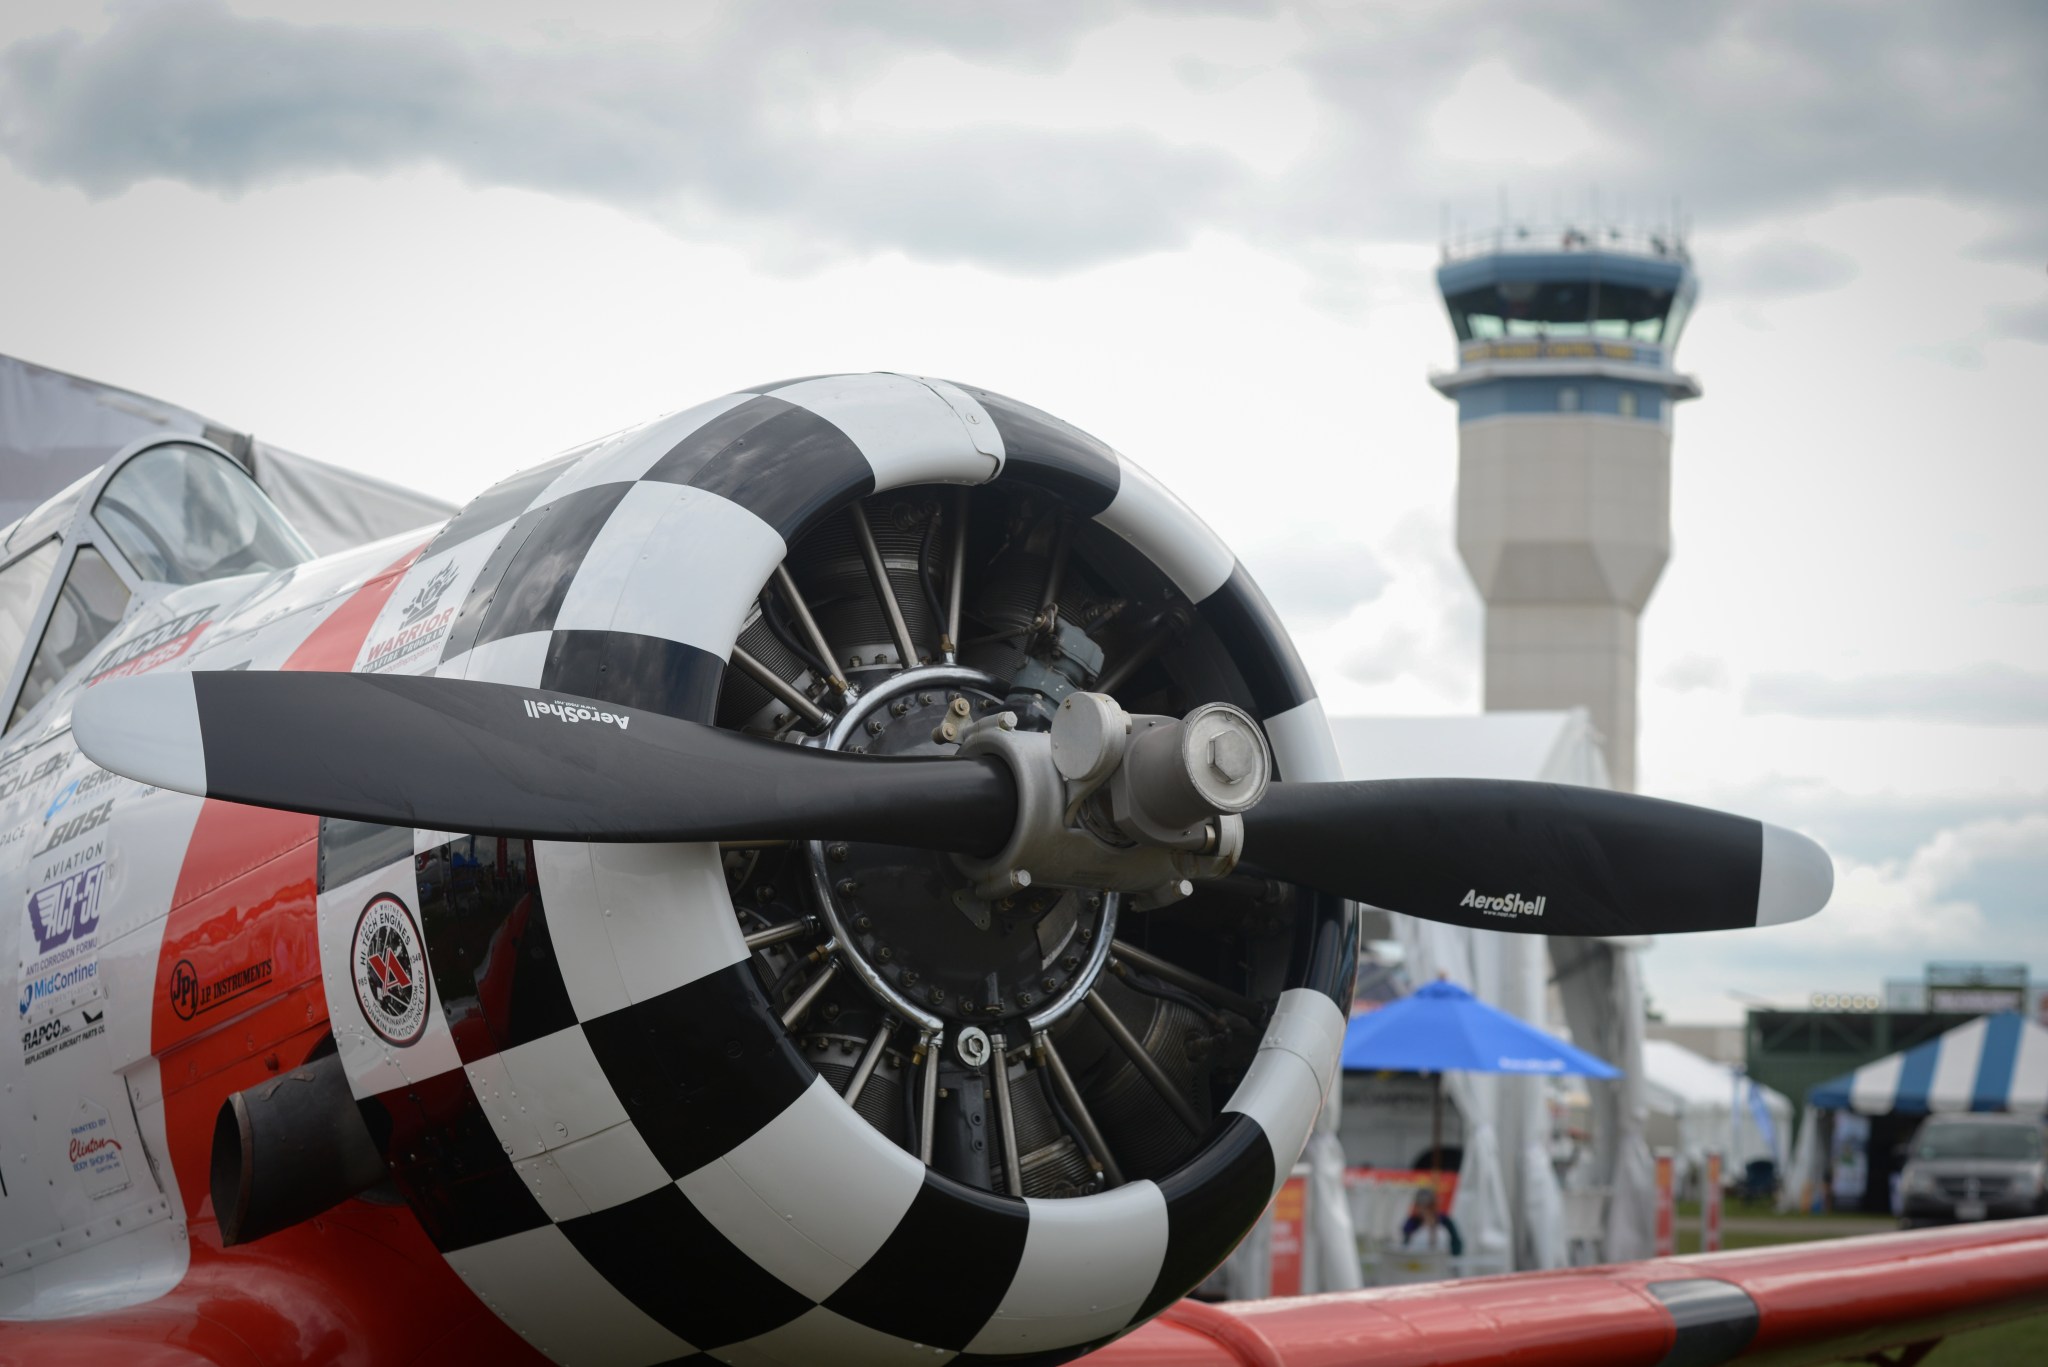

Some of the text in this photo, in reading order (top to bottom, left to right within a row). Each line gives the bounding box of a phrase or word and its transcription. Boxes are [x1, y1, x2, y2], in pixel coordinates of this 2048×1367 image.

[367, 607, 455, 663] WARRIOR
[524, 700, 629, 729] AeroShell
[41, 798, 115, 855] BOSE
[44, 840, 103, 882] AVIATION
[1460, 889, 1546, 916] AeroShell
[380, 913, 411, 947] ENGINES
[26, 961, 39, 976] ANTI
[41, 946, 75, 971] CORROSION
[213, 958, 272, 1000] INSTRUMENTS
[388, 1023, 415, 1038] AVIATION
[413, 998, 425, 1026] SINCE
[24, 1045, 58, 1066] REPLACEMENT
[59, 1035, 81, 1051] AIRCRAFT
[82, 1028, 97, 1041] PARTS
[69, 1137, 122, 1163] Clinton
